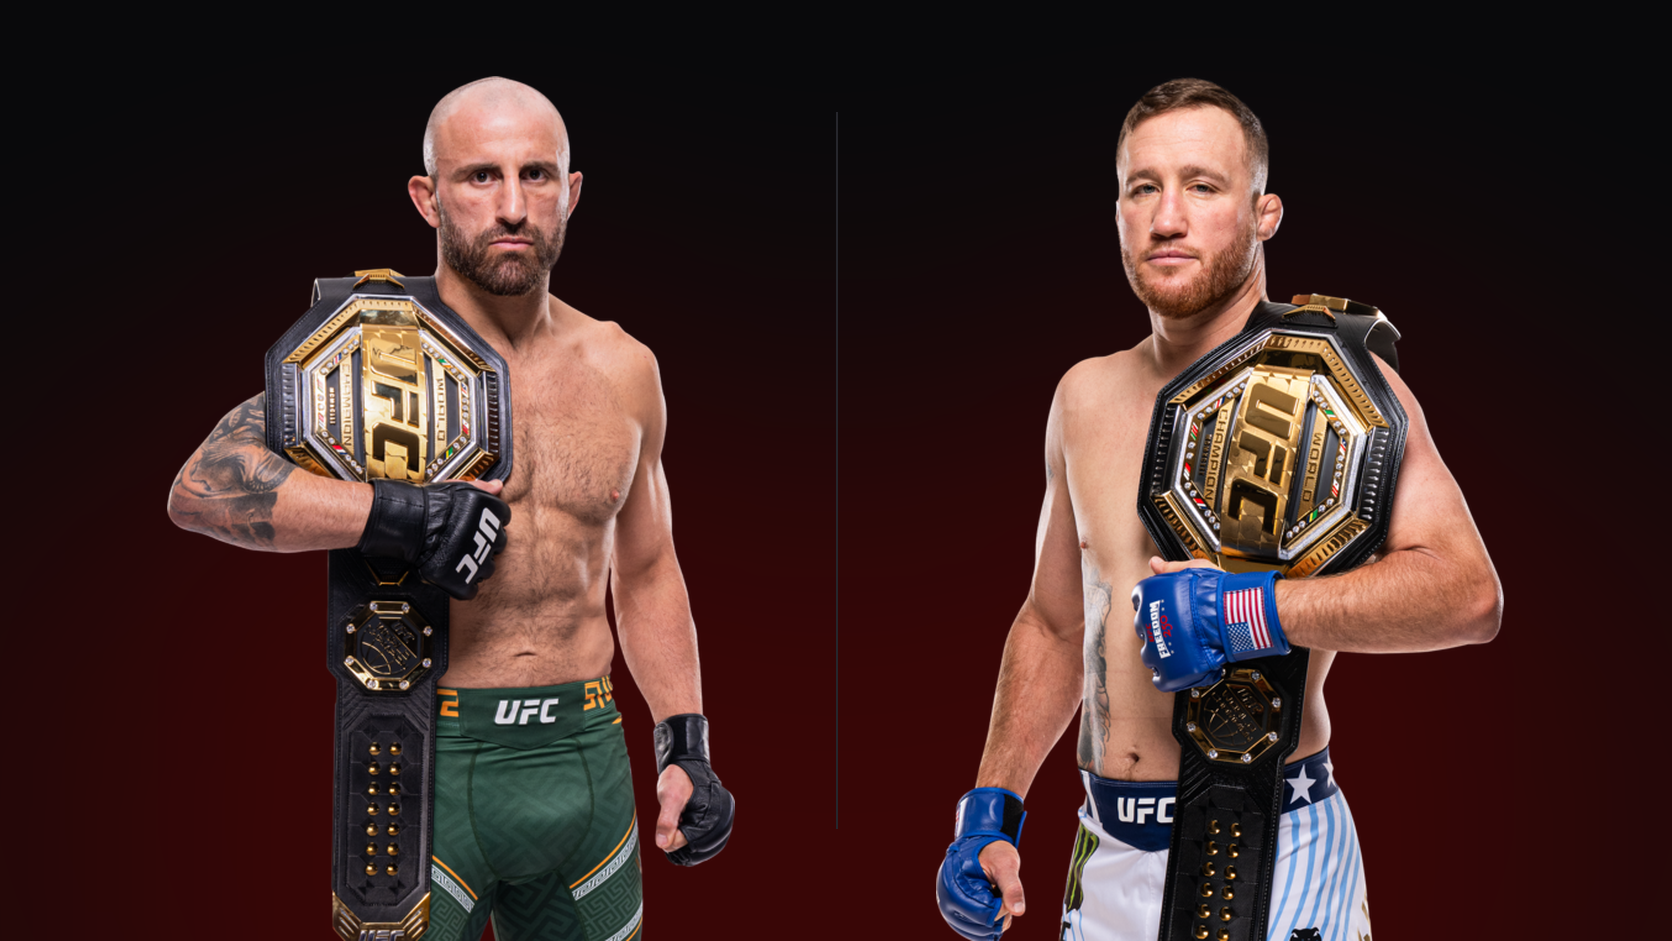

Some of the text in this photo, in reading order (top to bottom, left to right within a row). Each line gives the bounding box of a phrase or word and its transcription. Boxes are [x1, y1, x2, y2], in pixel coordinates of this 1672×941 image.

[341, 364, 352, 446] CHAMPION
[369, 337, 420, 473] UFC
[436, 378, 446, 441] WORLD
[1204, 409, 1228, 500] CHAMPION
[1228, 383, 1299, 535] UFC
[1303, 432, 1323, 501] WORLD
[455, 507, 500, 584] UFC
[1149, 600, 1171, 659] FREEDOM
[1160, 615, 1173, 638] 250
[494, 698, 559, 725] UFC
[1117, 797, 1177, 824] UFC
